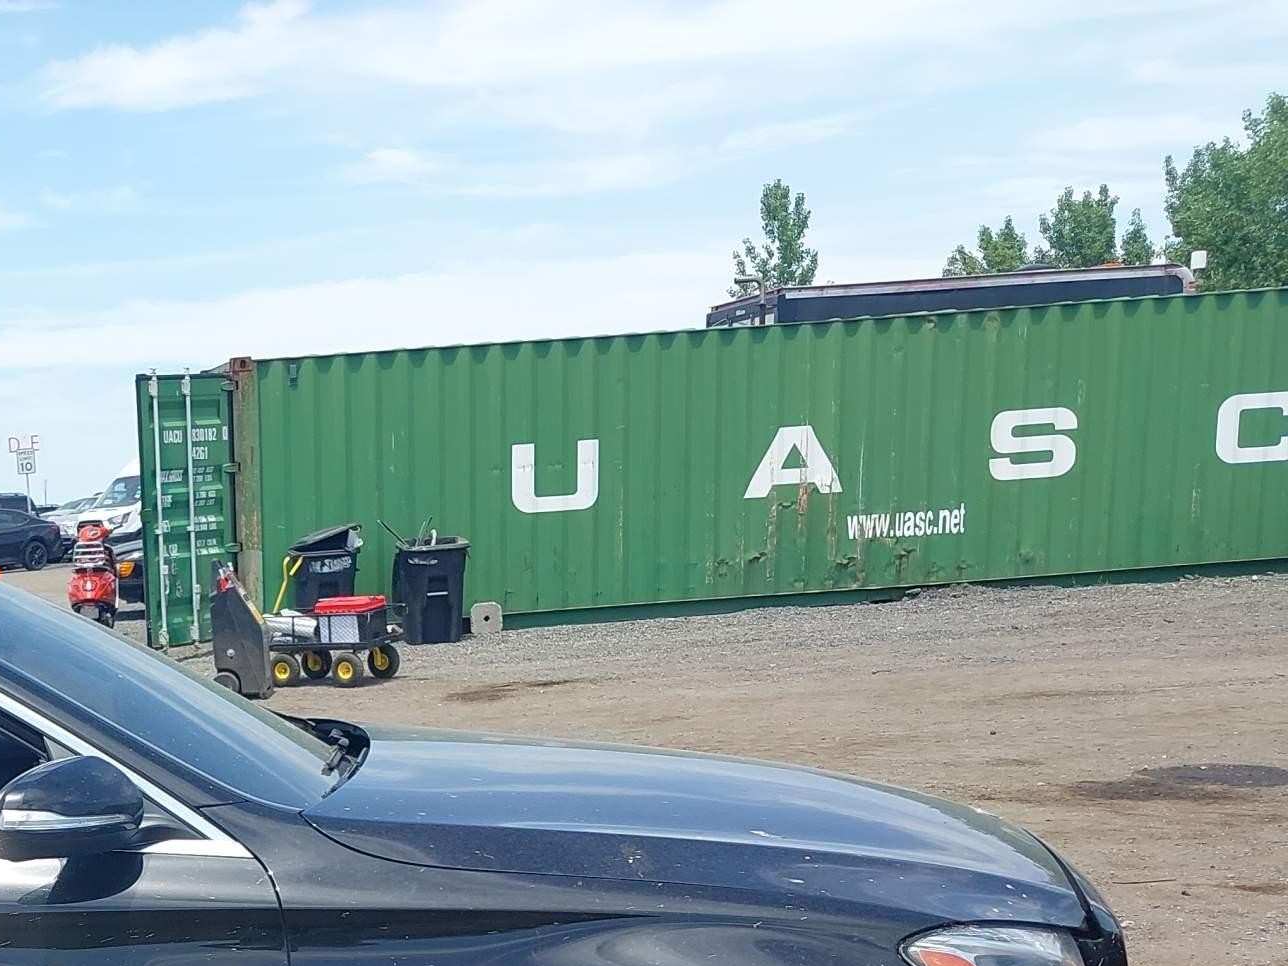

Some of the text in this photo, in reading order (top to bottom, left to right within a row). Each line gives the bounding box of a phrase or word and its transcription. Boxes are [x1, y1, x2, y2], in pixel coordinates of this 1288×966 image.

[163, 430, 183, 444] UACU
[20, 461, 33, 472] 10
[846, 502, 966, 540] www.uasc.net
